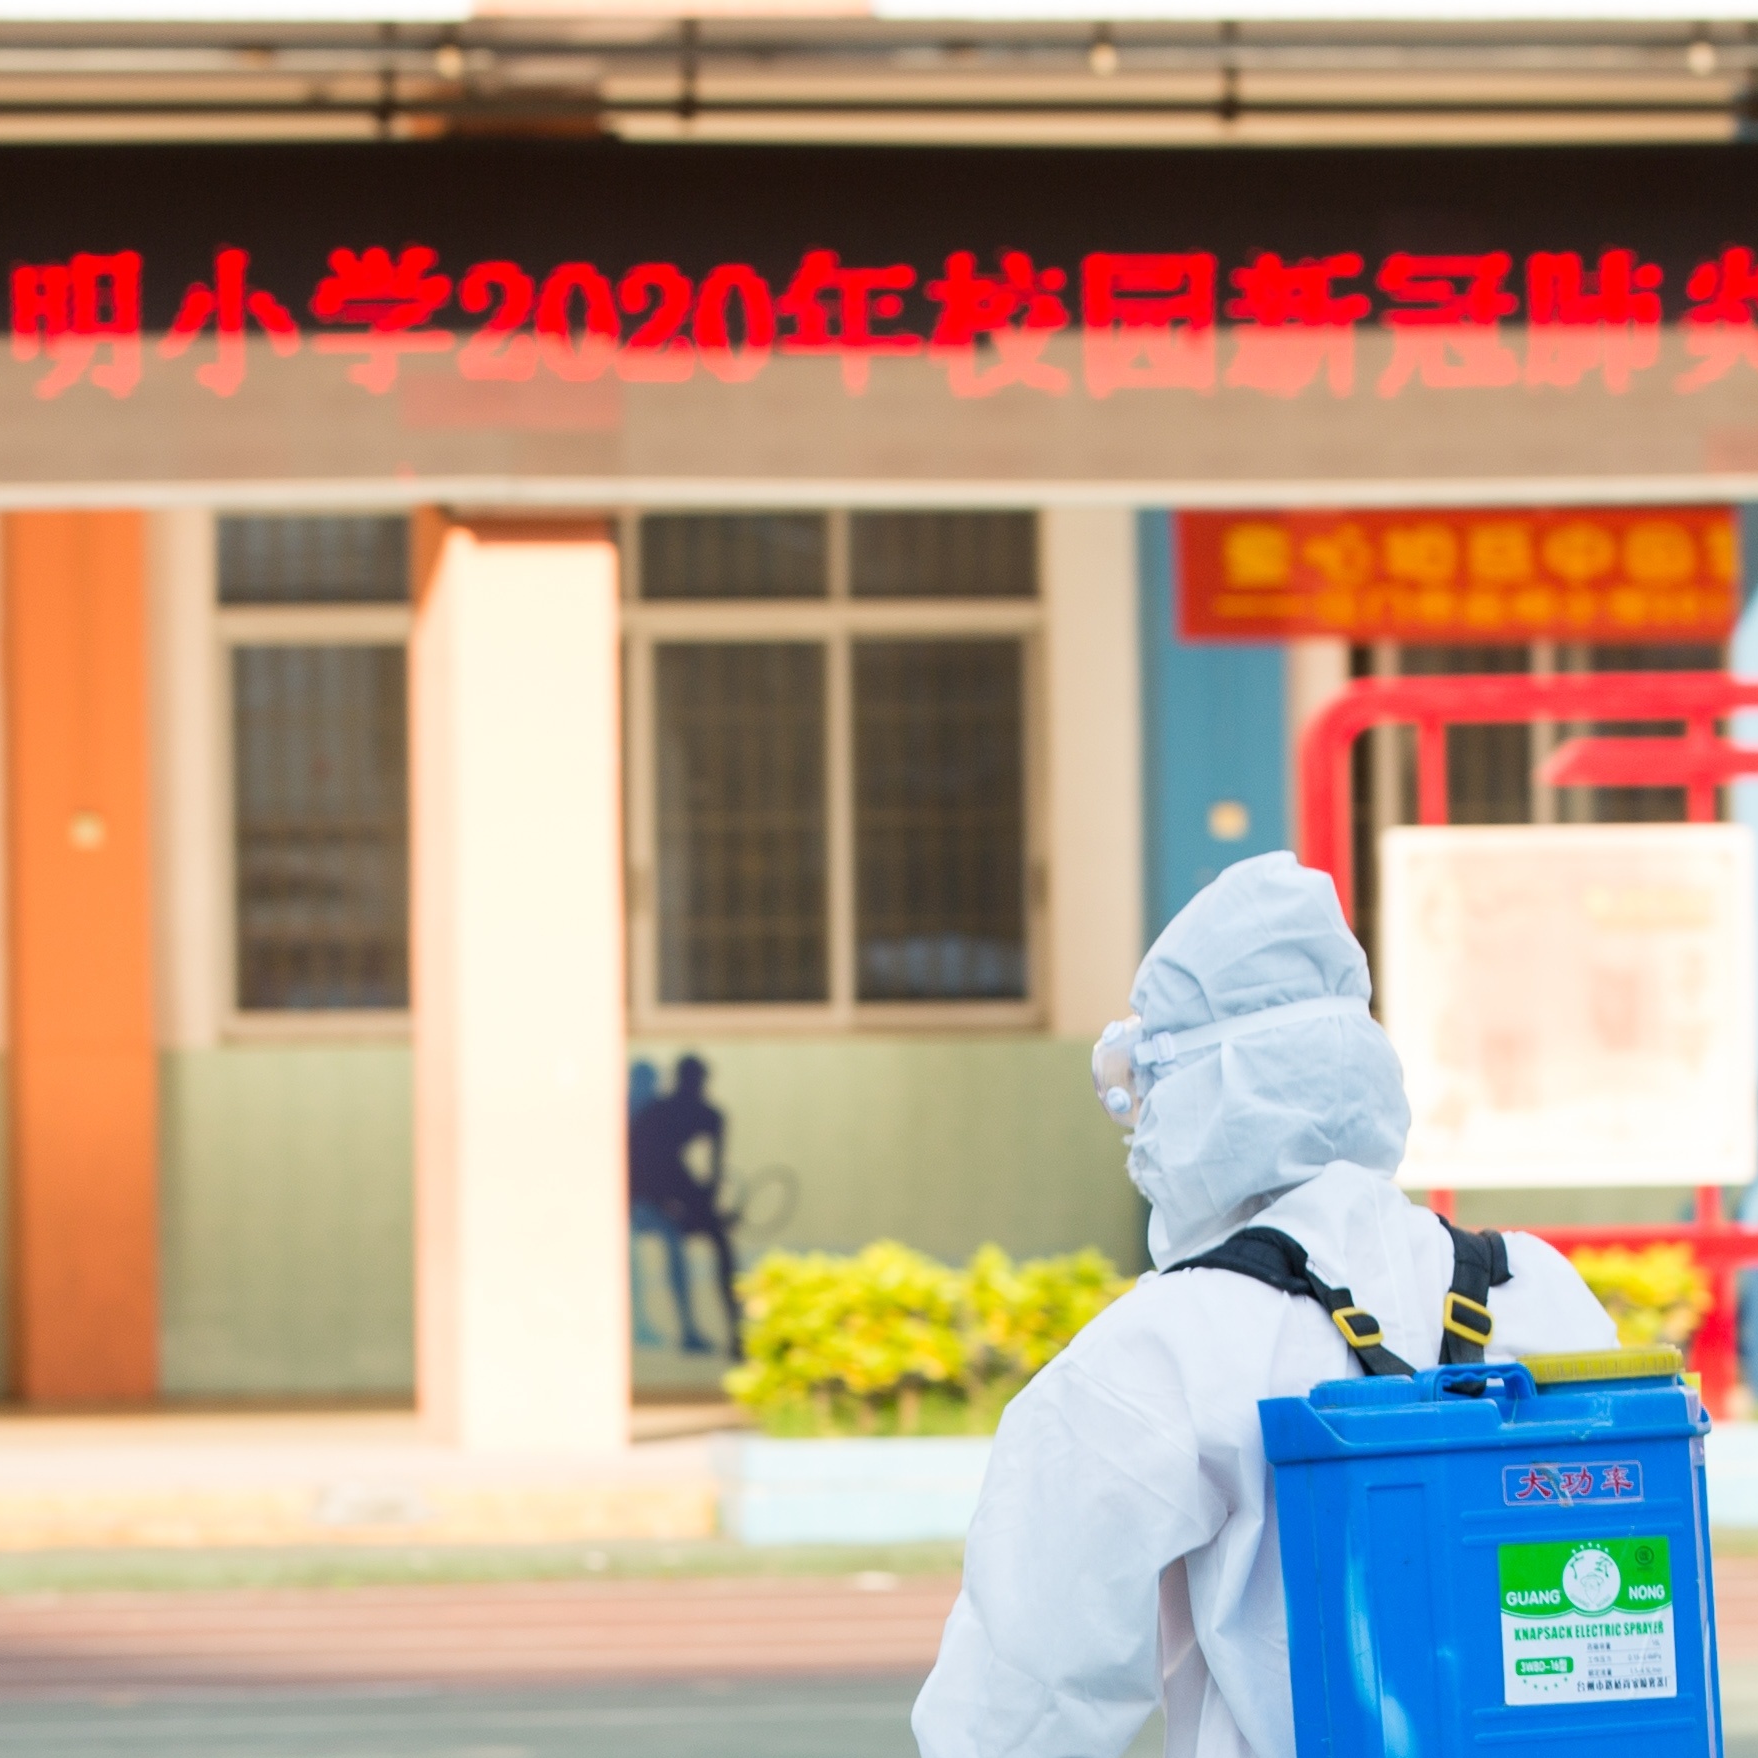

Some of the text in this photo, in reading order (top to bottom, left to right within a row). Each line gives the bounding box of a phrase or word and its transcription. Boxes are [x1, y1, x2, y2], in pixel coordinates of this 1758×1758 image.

[1515, 1465, 1633, 1498] 大功率
[1505, 1589, 1561, 1606] GUANG
[1628, 1584, 1665, 1600] NONG
[1514, 1620, 1664, 1641] KNAPSACK ELECTRIC SPRAYER
